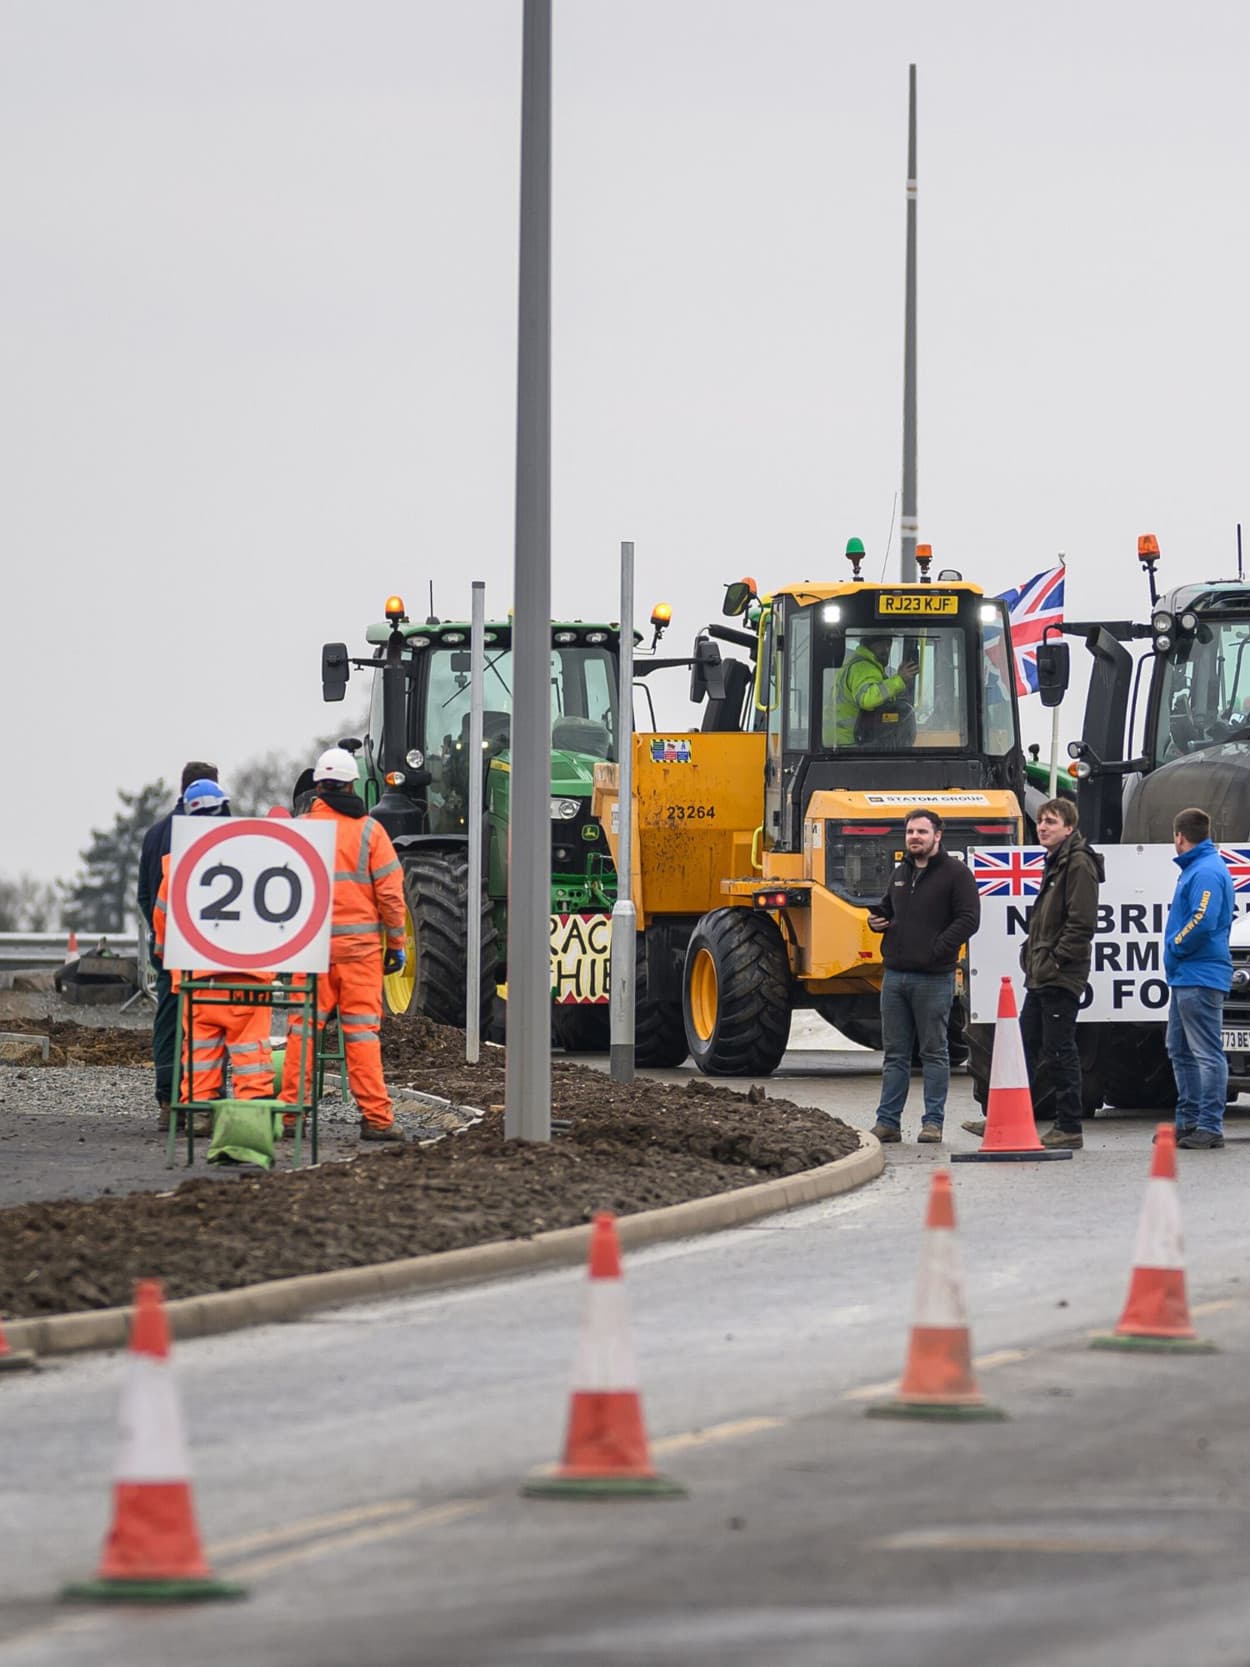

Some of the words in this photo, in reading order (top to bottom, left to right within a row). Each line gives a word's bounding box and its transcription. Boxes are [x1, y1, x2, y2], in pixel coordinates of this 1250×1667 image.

[886, 598, 920, 611] RJ23
[925, 598, 951, 611] KJF
[667, 805, 716, 819] 23264
[200, 863, 302, 922] 20
